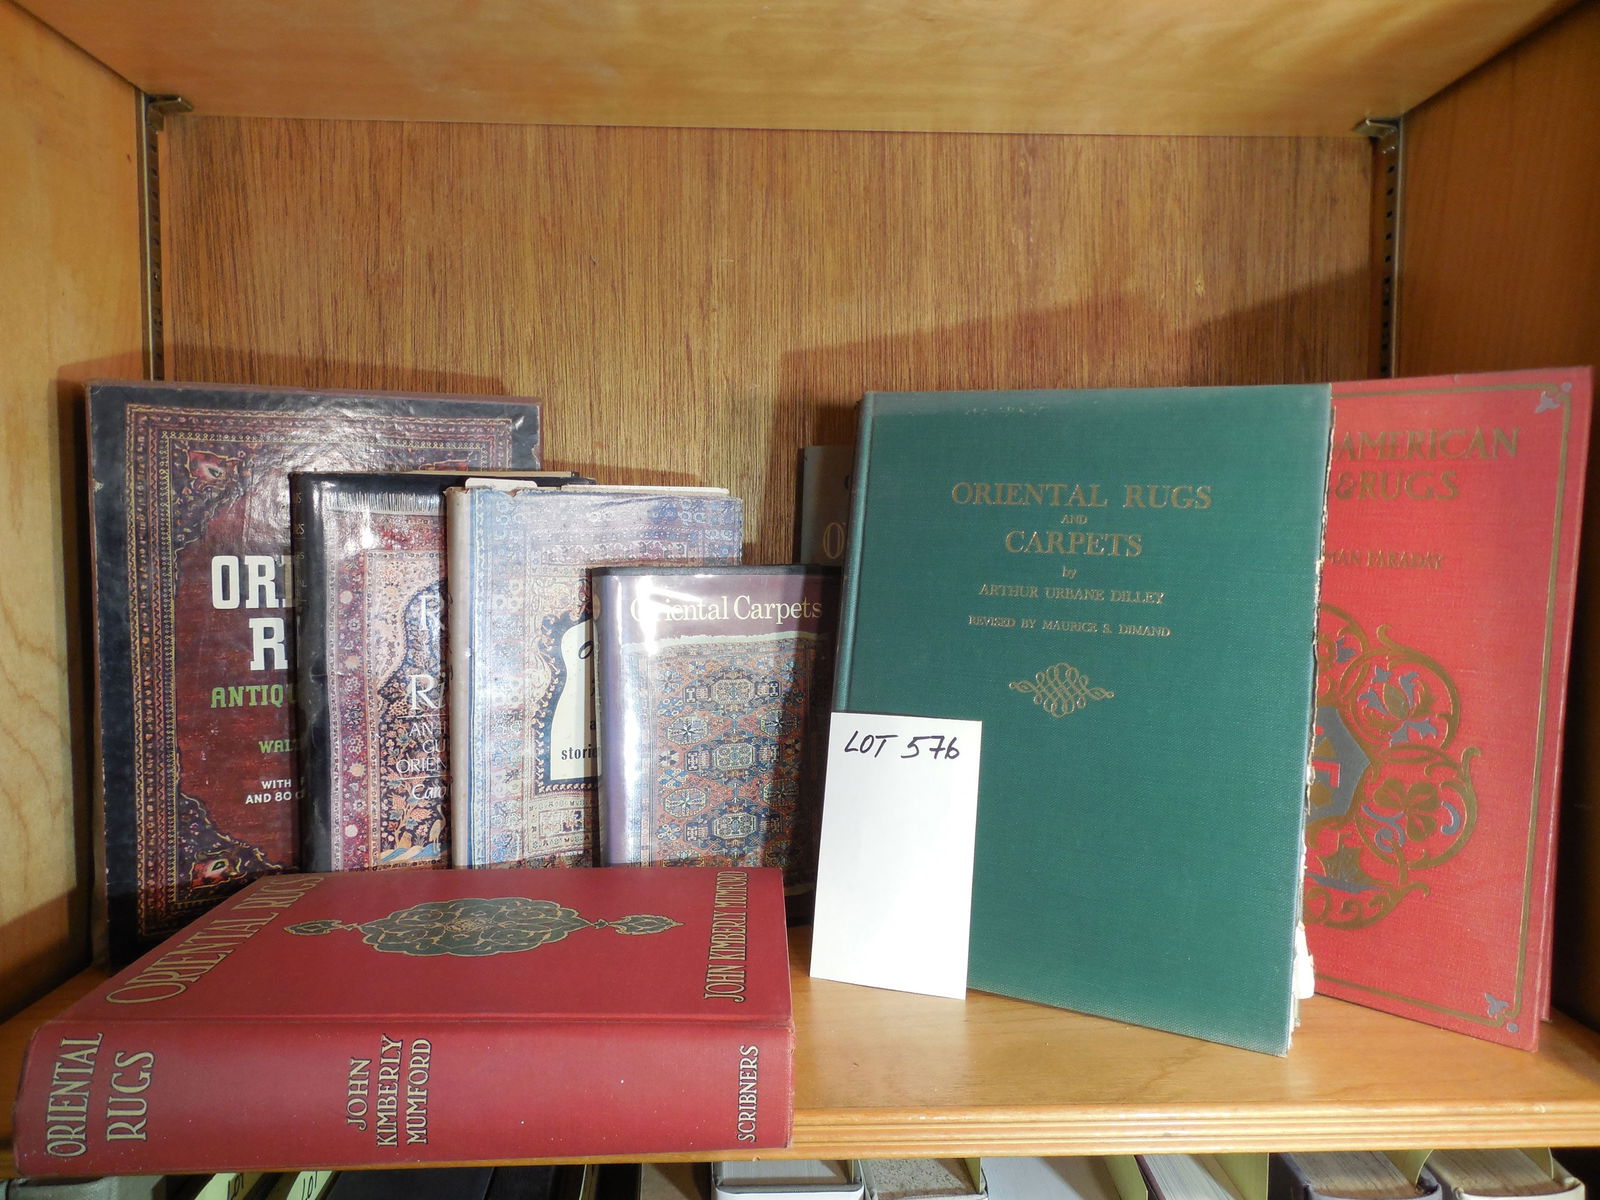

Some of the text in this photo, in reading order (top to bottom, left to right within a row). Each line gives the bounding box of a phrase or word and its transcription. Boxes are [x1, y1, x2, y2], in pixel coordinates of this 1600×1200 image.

[951, 482, 1213, 510] ORIENTAL RUGS
[1061, 514, 1088, 525] AND
[1004, 530, 1144, 557] CARPETS
[1062, 566, 1077, 579] by
[978, 584, 1039, 599] ARTHUR
[1045, 587, 1105, 602] URBANE
[630, 595, 823, 625] Oiental Carpets
[967, 615, 1016, 628] REVISED
[1022, 618, 1037, 630] BY
[1042, 620, 1098, 634] MAURICE
[1118, 624, 1172, 638] DIMAND
[844, 730, 960, 760] LOT 576
[245, 793, 272, 805] AND
[274, 791, 292, 802] 80
[261, 779, 292, 790] WITH
[105, 876, 324, 1004] ORIENTAL RUGS
[704, 870, 749, 1003] JOHN KIMBERLY MUMFORD
[46, 1032, 104, 1157] ORIENTAL
[106, 1051, 155, 1141] RUGS
[346, 1057, 372, 1131] JOHN
[376, 1034, 404, 1147] KIMBERLY
[406, 1038, 433, 1145] MUMFORD
[737, 1044, 760, 1143] SCRIBNERS
